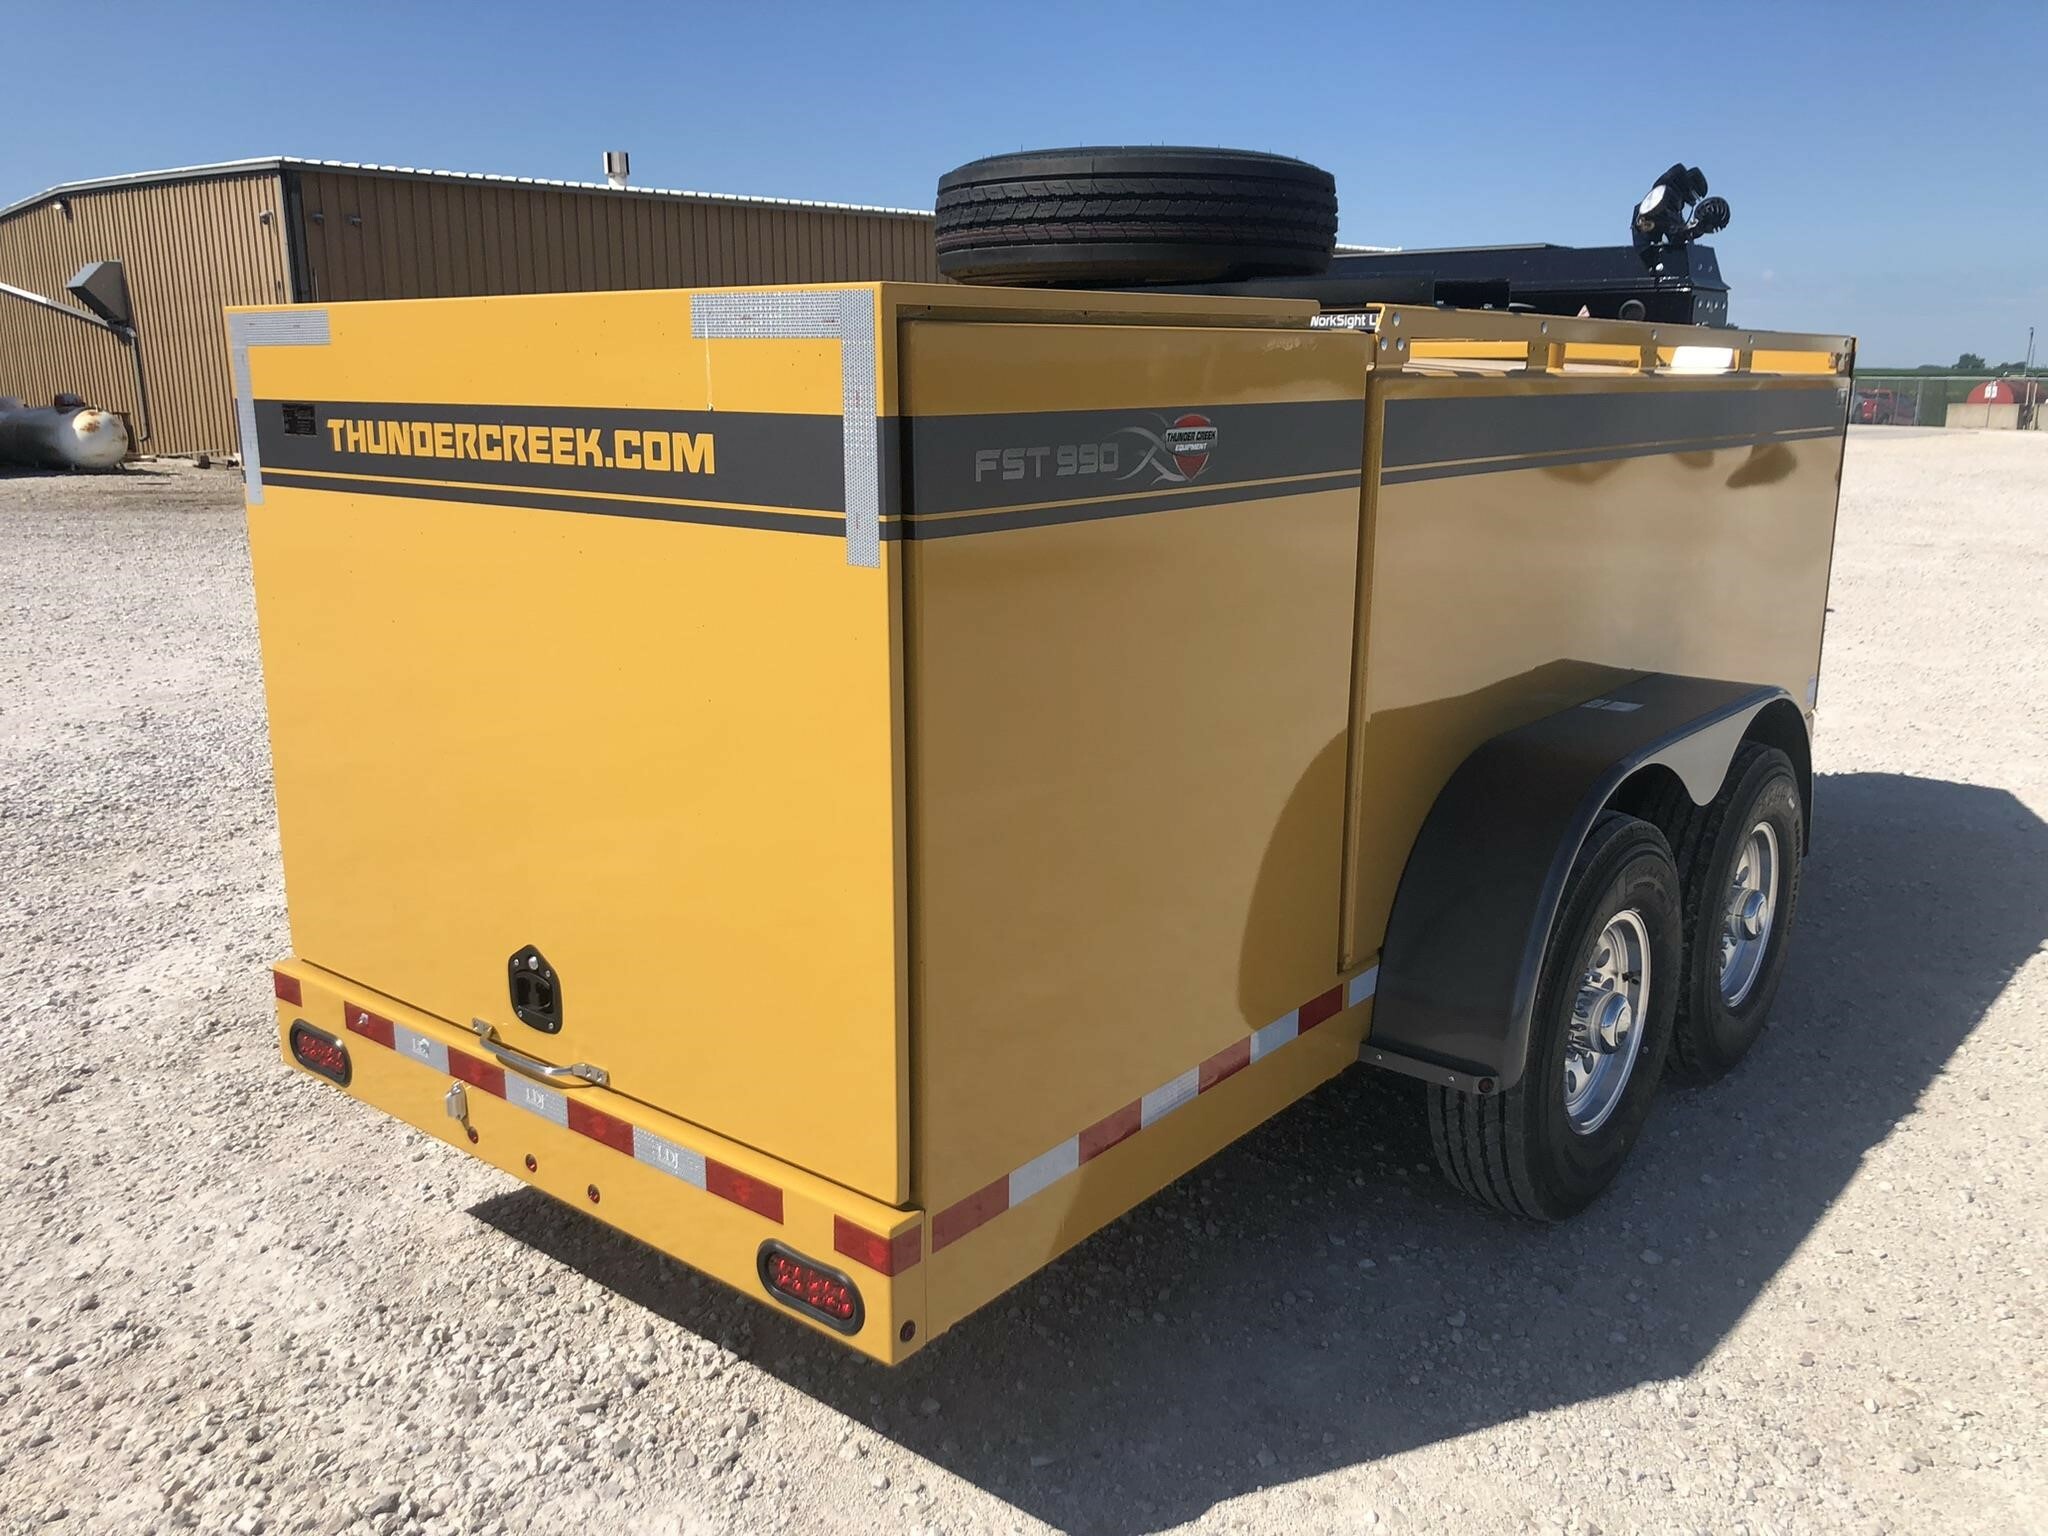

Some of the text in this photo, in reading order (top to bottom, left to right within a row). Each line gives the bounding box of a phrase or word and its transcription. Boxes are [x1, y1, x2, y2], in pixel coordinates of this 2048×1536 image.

[327, 418, 716, 474] THUNDERCREEK.COM
[1167, 430, 1216, 442] THUNDER CREEK
[975, 442, 1119, 482] FST 990
